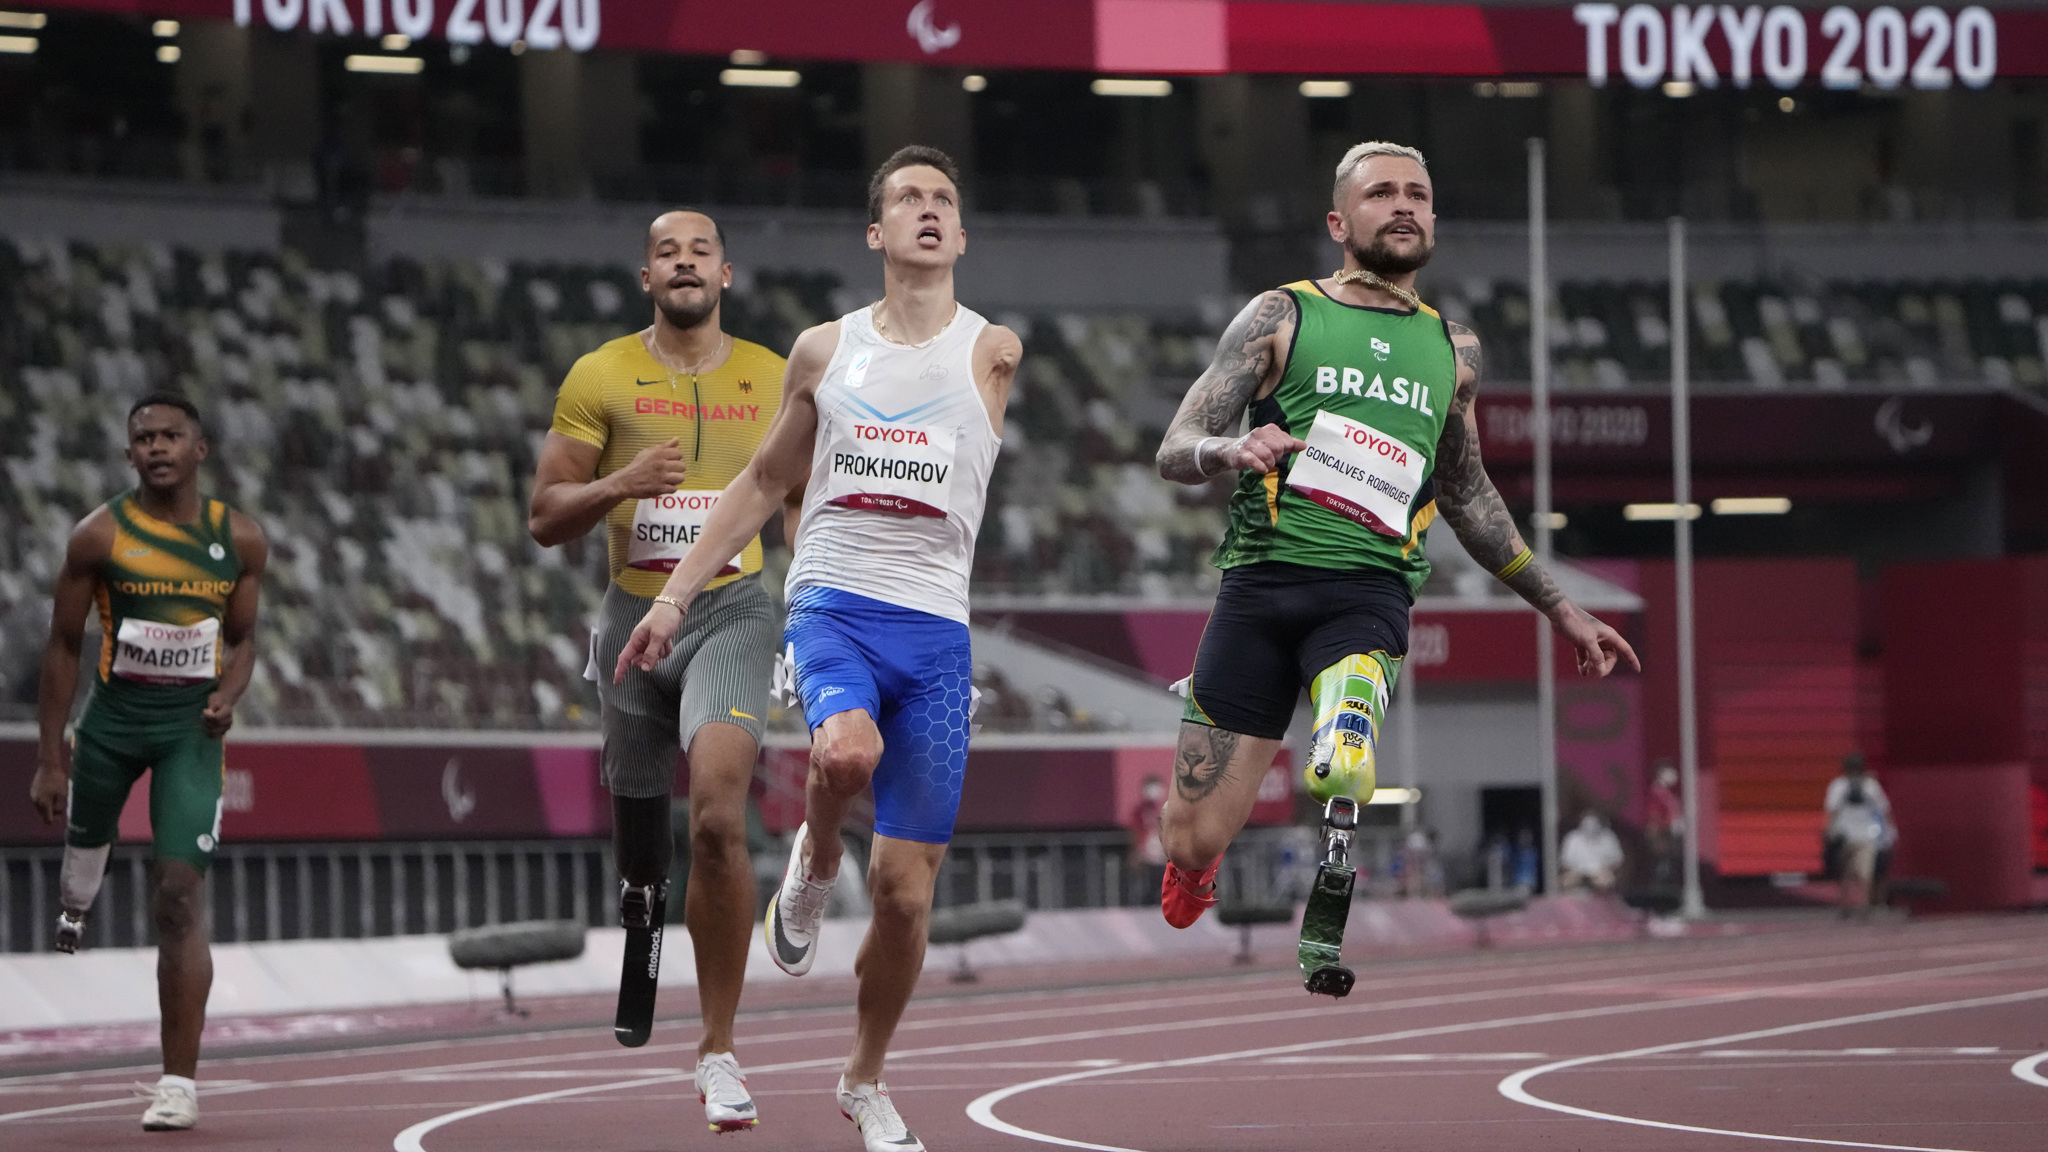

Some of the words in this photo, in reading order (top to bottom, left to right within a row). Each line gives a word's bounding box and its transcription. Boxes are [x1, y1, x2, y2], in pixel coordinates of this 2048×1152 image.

[445, 0, 601, 52] 2020
[1573, 2, 1807, 90] TOKYO
[1819, 5, 1998, 90] 2020
[1316, 366, 1433, 417] BRASIL
[635, 397, 760, 421] GERMANY
[854, 425, 929, 446] TOYOTA
[1344, 424, 1408, 468] TOYOTA
[834, 453, 949, 484] PROKHOROV
[1306, 446, 1366, 482] GONCALVES
[1366, 474, 1411, 506] RODRIGUES
[1325, 496, 1346, 510] TOKYO
[1345, 505, 1360, 517] 2020
[143, 626, 203, 642] TOYOTA
[124, 642, 213, 667] MABOTE
